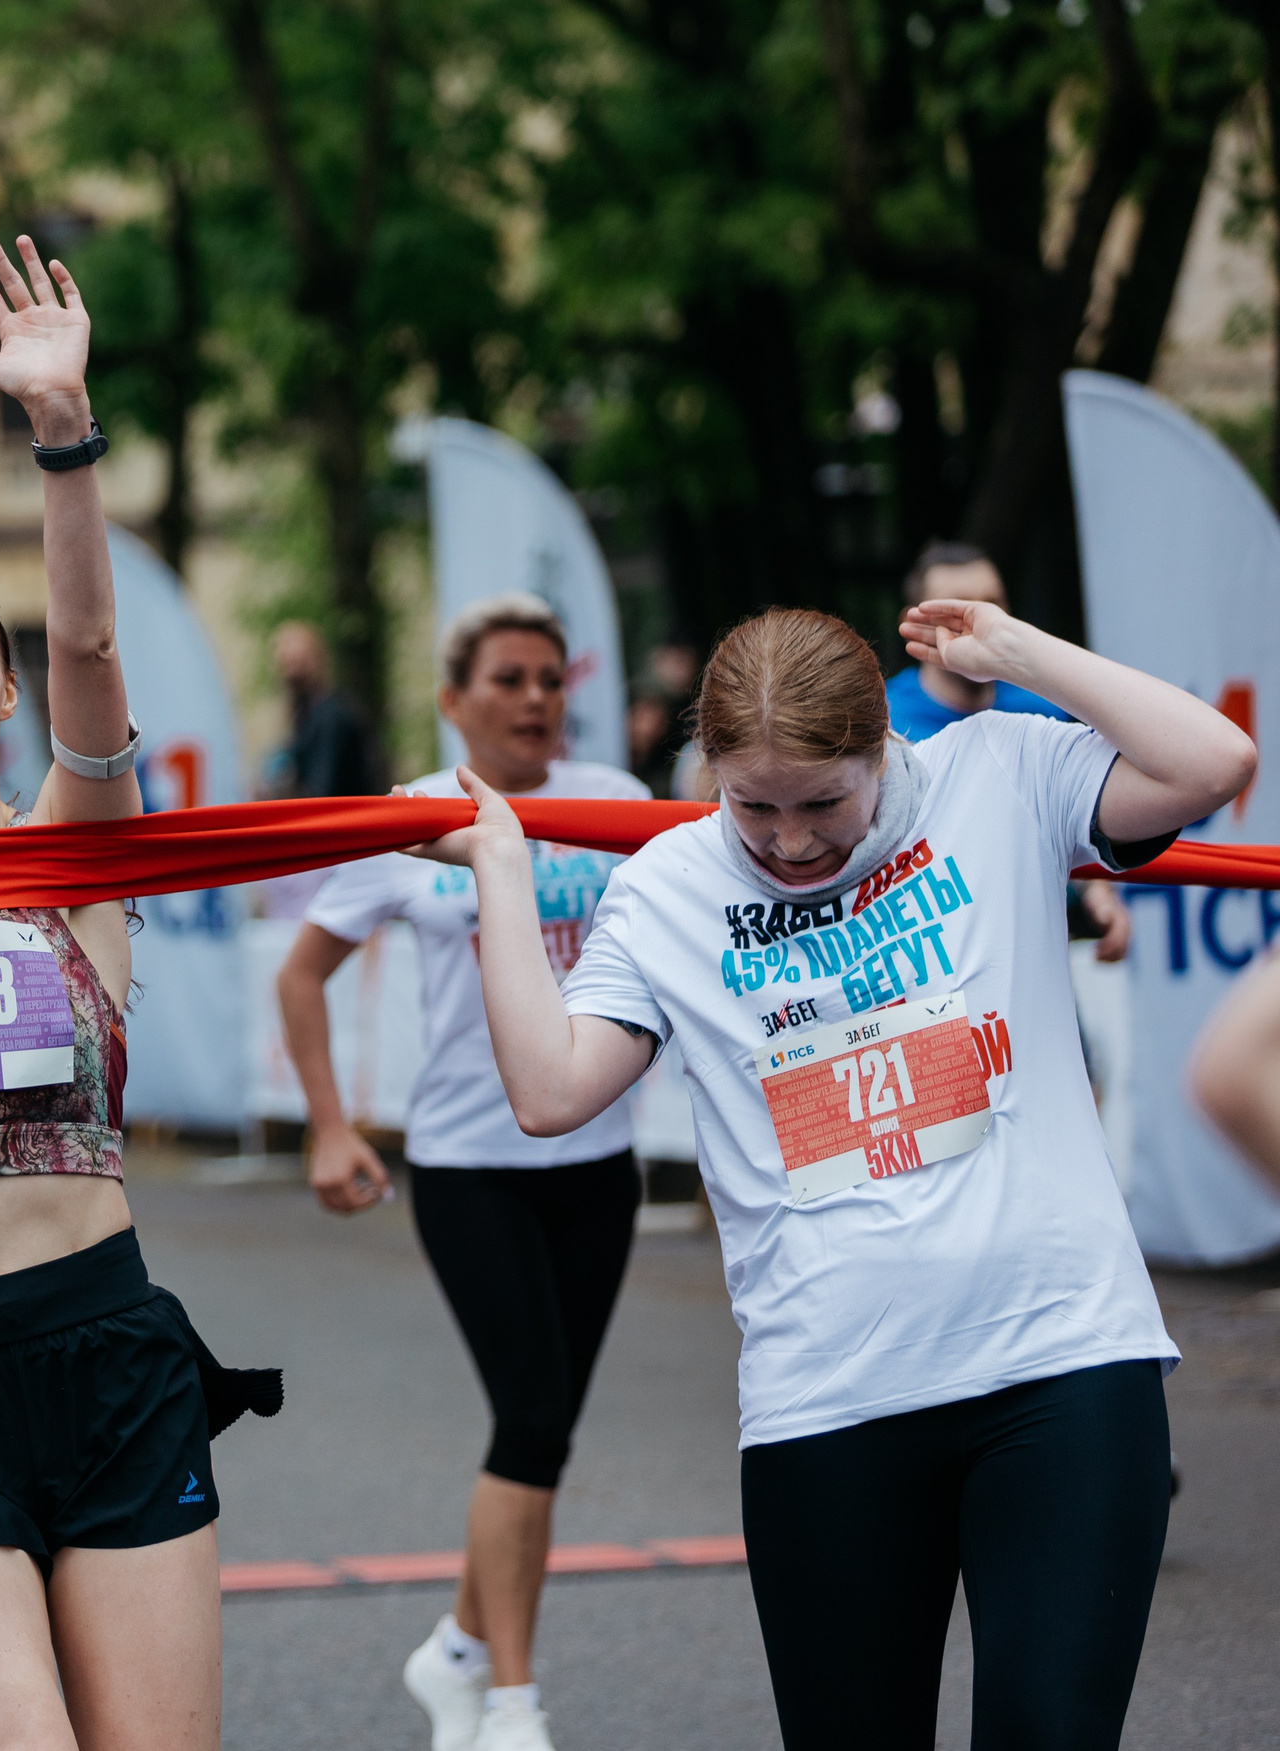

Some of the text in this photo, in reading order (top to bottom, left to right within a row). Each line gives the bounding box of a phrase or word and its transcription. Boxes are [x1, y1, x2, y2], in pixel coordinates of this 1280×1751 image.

[720, 856, 973, 998] 45% ПЛАНЕТЫ
[841, 922, 954, 1014] БЕГУТ
[24, 998, 68, 1011] ПЕРЕЗАГРУЗКА
[788, 1044, 816, 1062] ПСБ
[832, 1041, 916, 1123] 721
[870, 1116, 900, 1138] ЮЛИЯ
[866, 1131, 922, 1180] 5КМ
[178, 1494, 205, 1504] DEMIX
